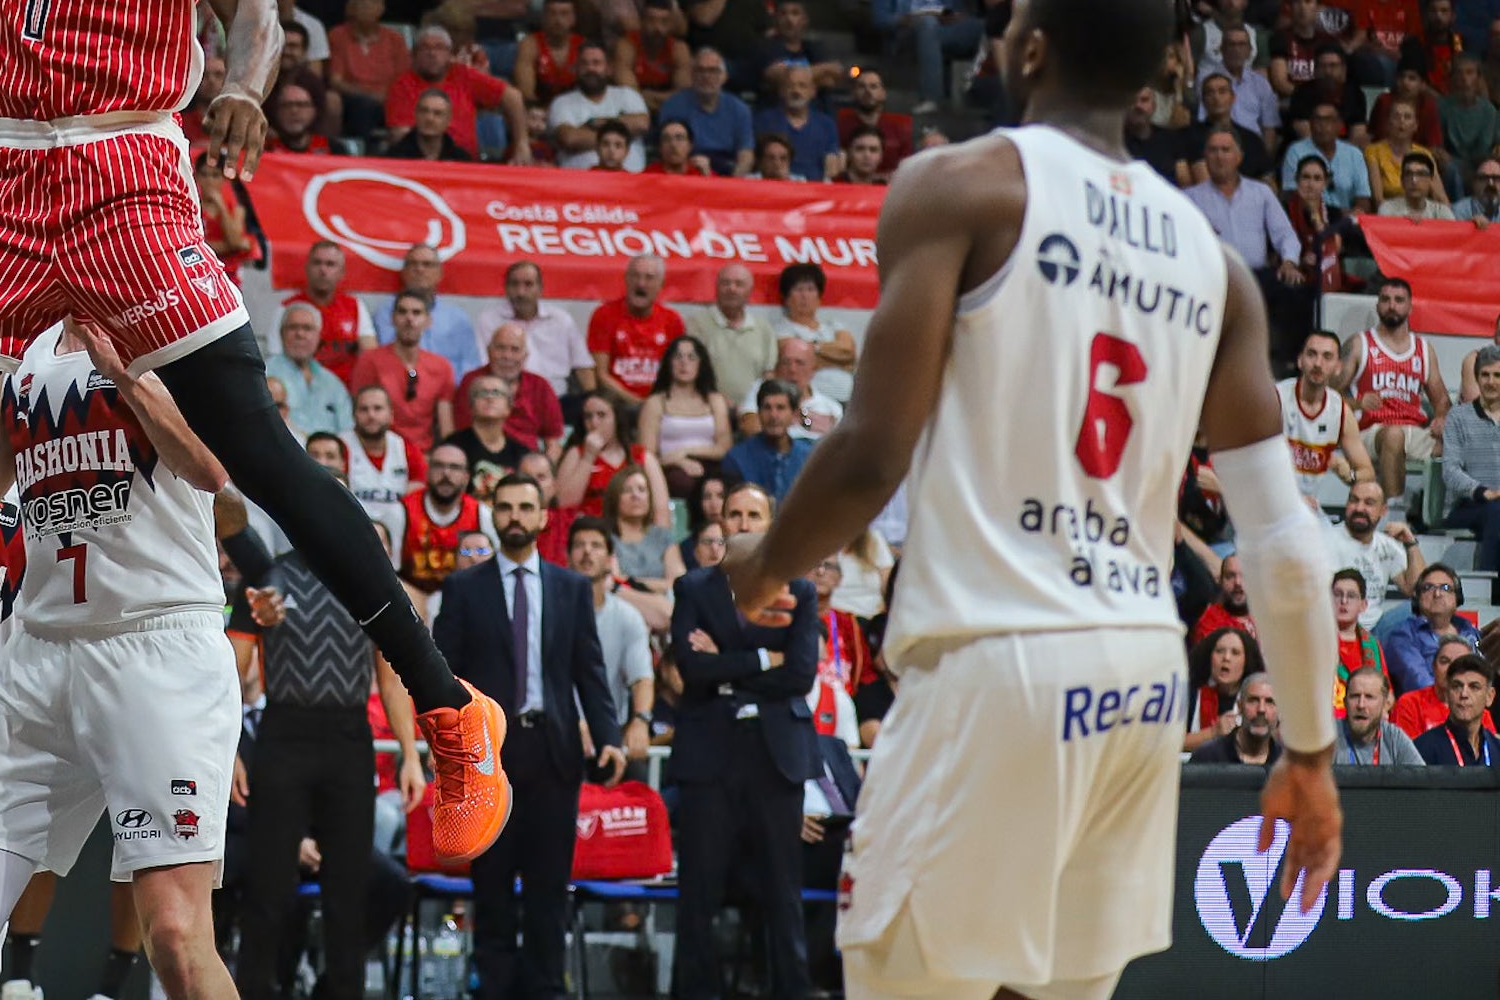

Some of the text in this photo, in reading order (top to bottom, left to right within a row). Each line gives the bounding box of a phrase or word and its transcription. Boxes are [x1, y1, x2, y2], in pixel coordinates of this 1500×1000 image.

[486, 199, 640, 226] Costa Cálida
[496, 222, 694, 259] REGIÓN
[700, 229, 768, 263] DE
[1074, 331, 1148, 481] 6
[1372, 371, 1421, 395] UCAM
[15, 427, 135, 495] BASKONIA
[56, 543, 88, 605] 7
